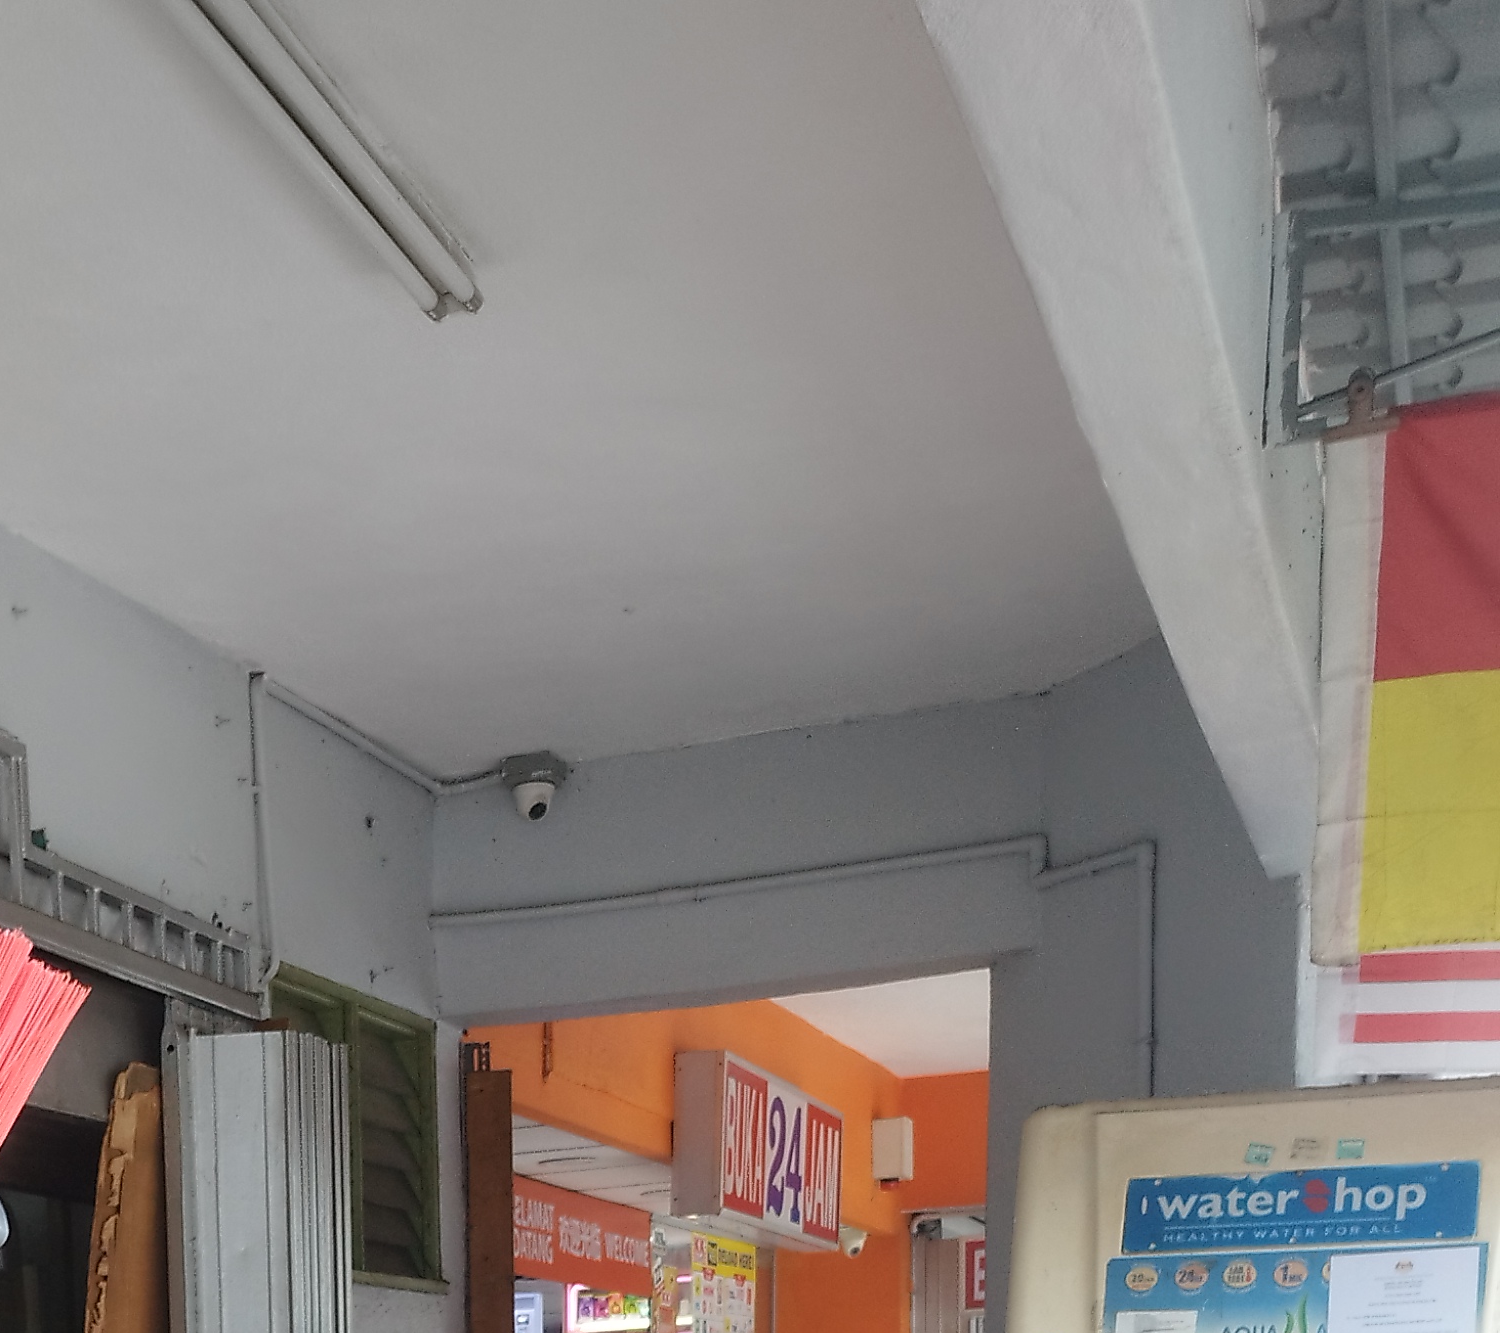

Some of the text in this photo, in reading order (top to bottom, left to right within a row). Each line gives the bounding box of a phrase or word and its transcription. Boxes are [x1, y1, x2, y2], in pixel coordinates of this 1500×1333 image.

[725, 1077, 839, 1231] BUKA 24 JAM
[604, 1231, 649, 1268] WELCOME
[1163, 1231, 1244, 1243] HEALTHY
[1254, 1227, 1315, 1239] WATER
[1325, 1225, 1360, 1237] FOR
